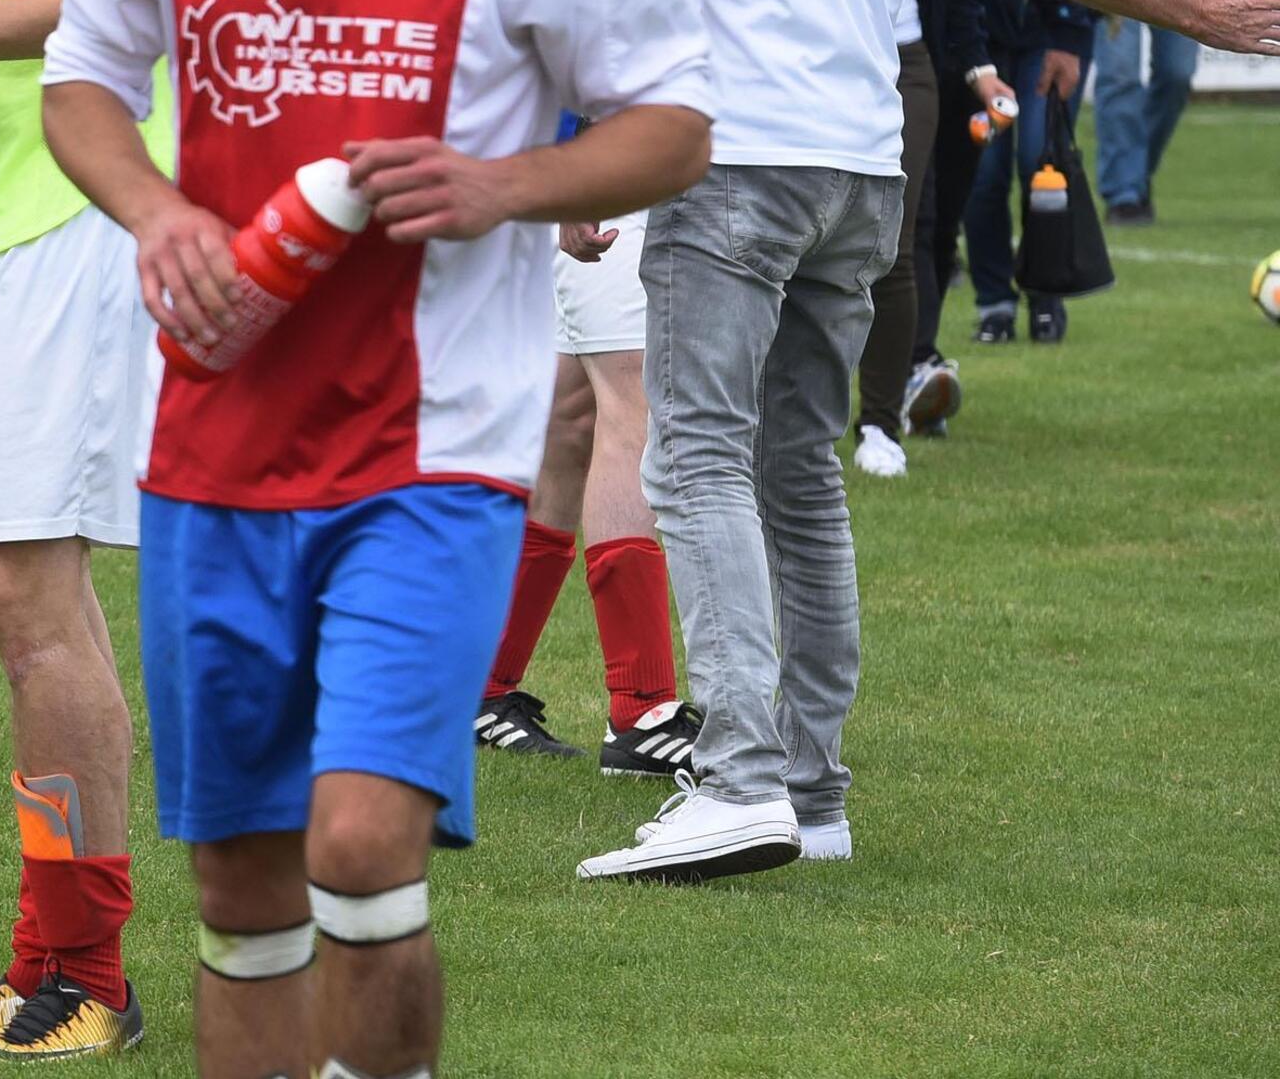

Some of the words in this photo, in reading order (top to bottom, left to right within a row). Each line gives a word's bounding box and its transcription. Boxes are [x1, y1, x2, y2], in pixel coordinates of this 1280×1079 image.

[236, 12, 438, 50] WITTE
[235, 44, 435, 70] INSTALLATIE
[236, 67, 433, 102] URSEM
